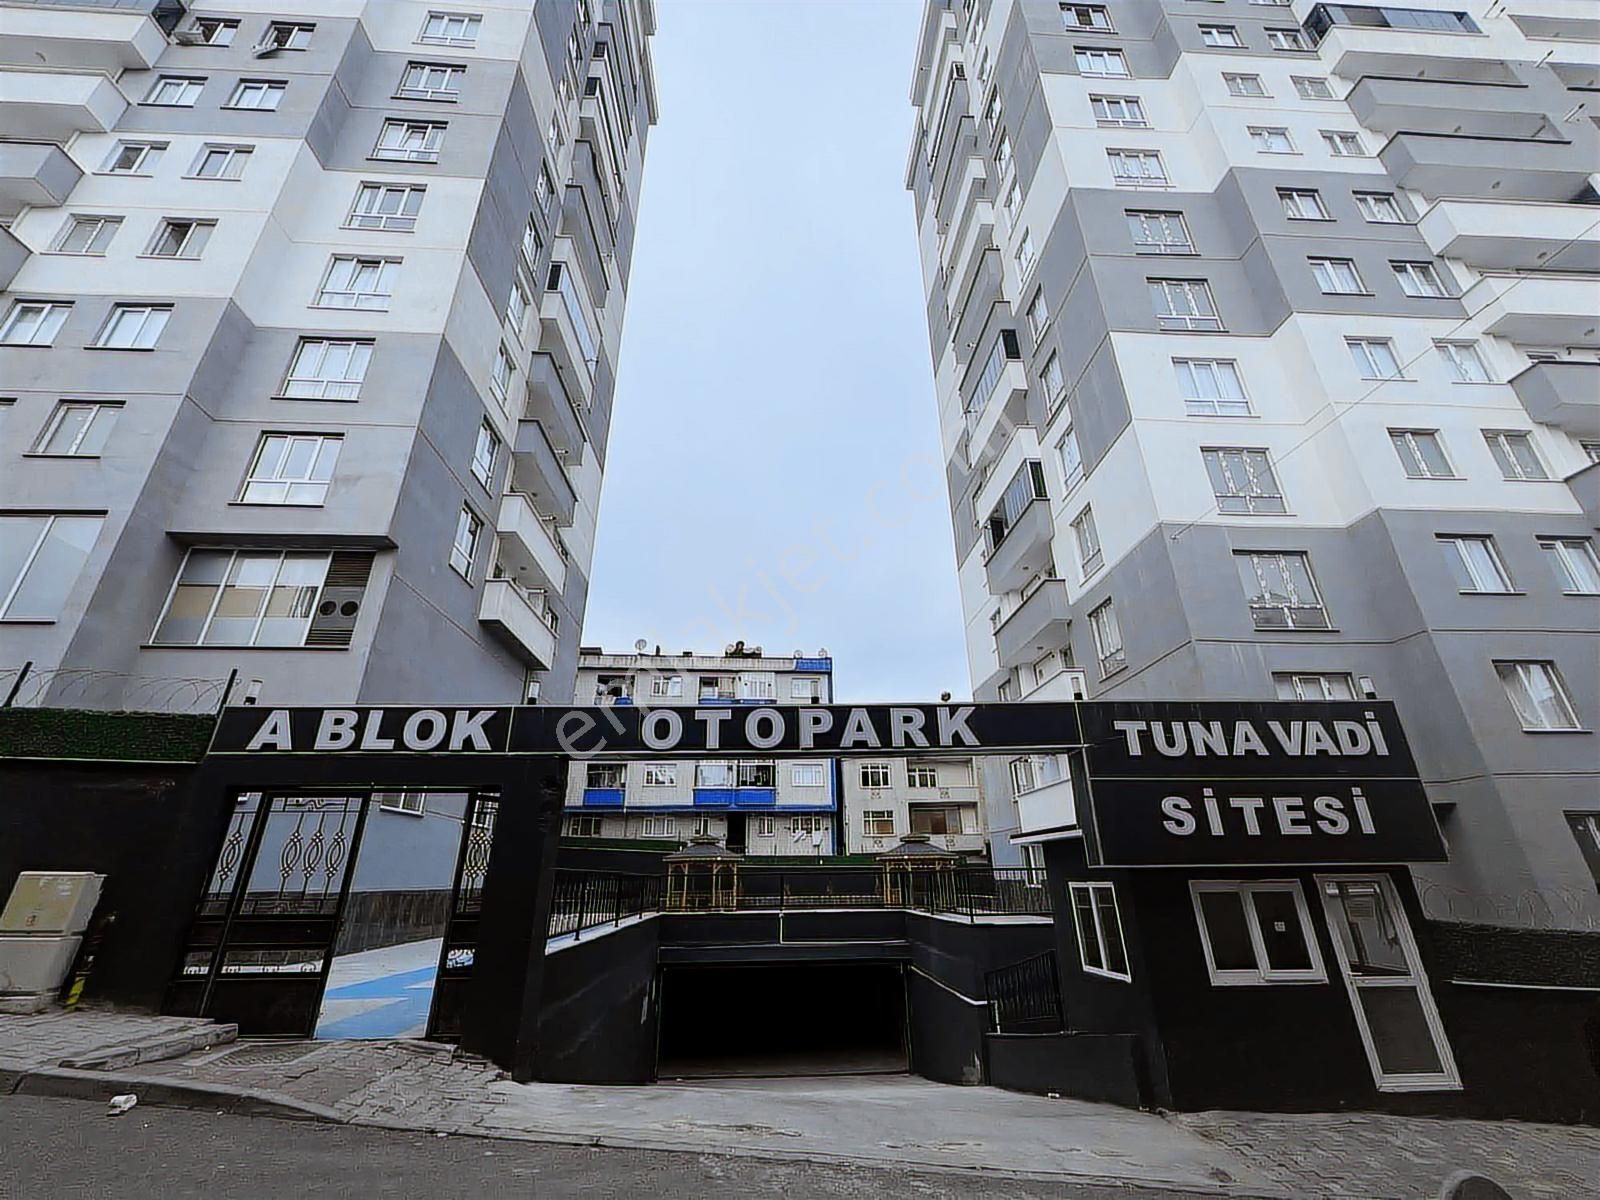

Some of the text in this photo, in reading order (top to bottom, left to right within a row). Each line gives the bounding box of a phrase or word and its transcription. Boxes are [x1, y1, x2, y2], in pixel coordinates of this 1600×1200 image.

[246, 709, 497, 751] A BLOK
[641, 706, 981, 750] OTOPARK
[1113, 720, 1270, 757] TUNA
[1160, 787, 1377, 836] SİTESİ
